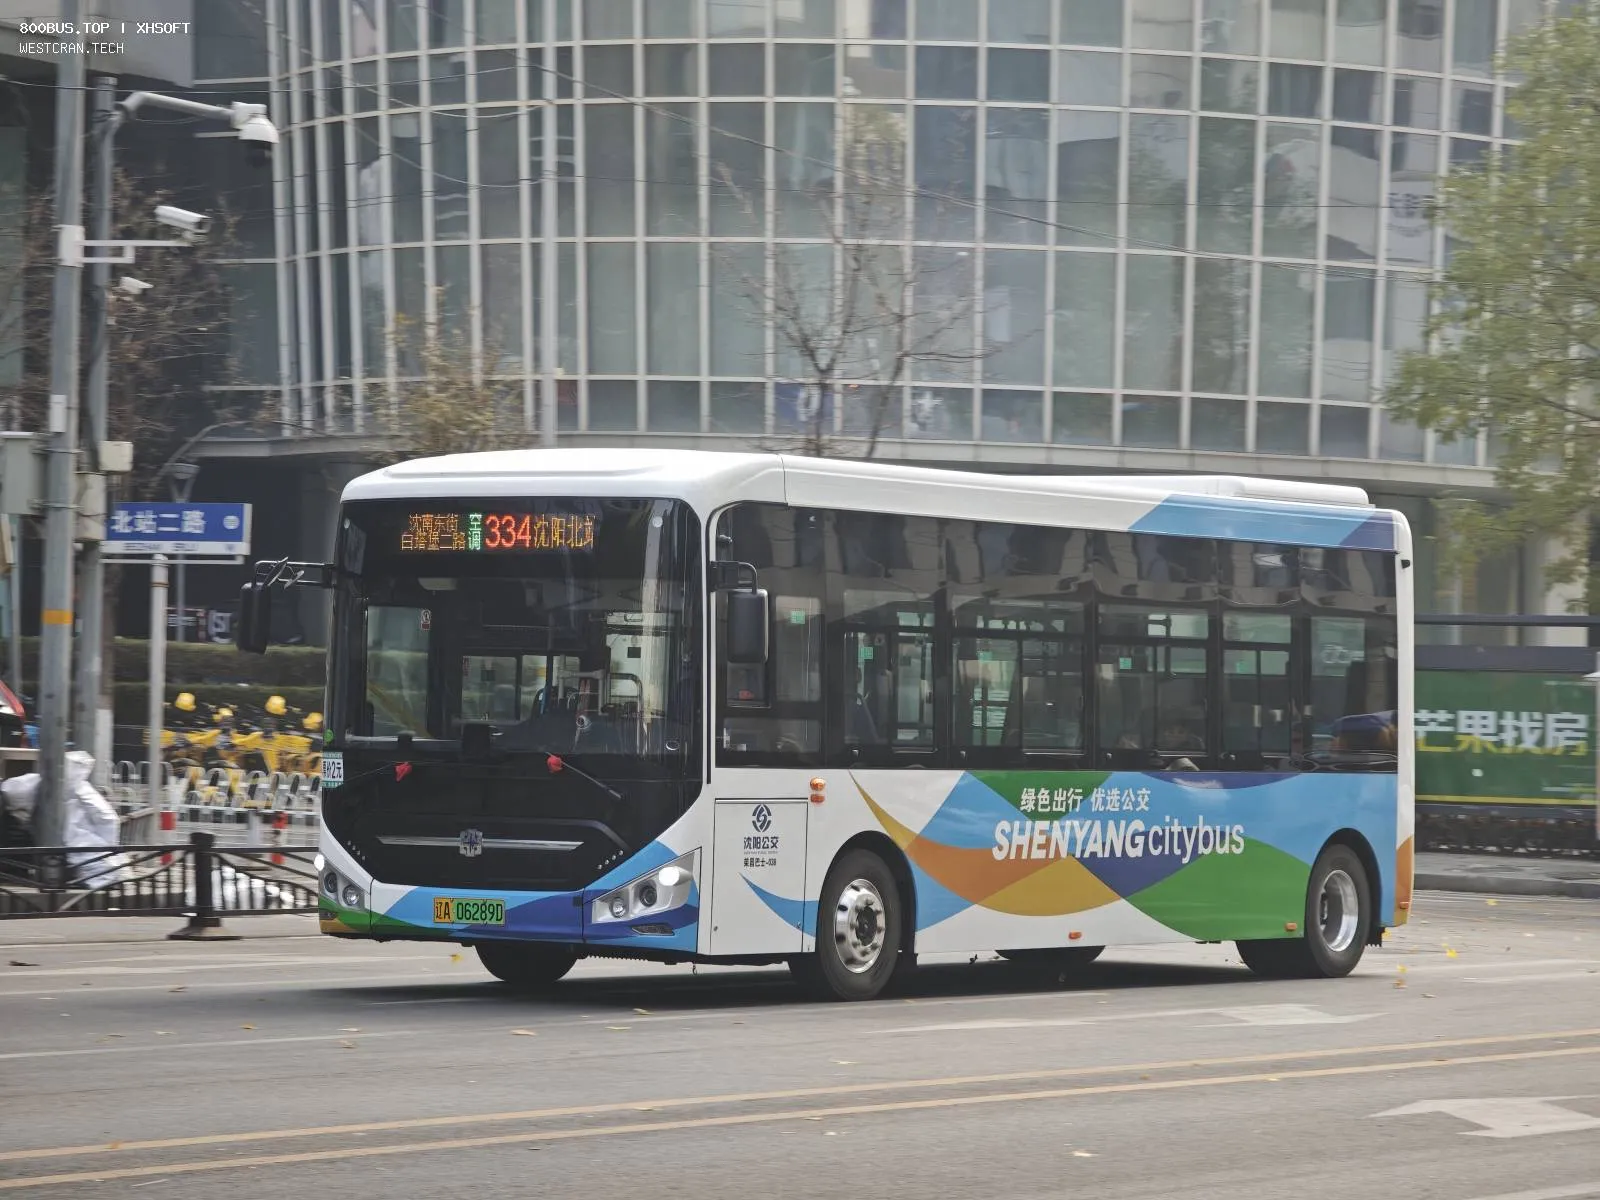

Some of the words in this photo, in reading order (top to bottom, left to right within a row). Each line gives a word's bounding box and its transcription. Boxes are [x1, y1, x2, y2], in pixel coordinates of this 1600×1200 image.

[111, 510, 206, 534] 北站二路
[468, 513, 483, 550] 空调
[485, 514, 531, 548] 334
[1413, 709, 1589, 756] 芒果找房
[1020, 787, 1083, 813] 绿色出行
[1090, 787, 1152, 813] 优选公交
[743, 836, 779, 850] 沈阳公交
[992, 819, 1146, 861] SHENYANG
[1148, 815, 1246, 864] citybus
